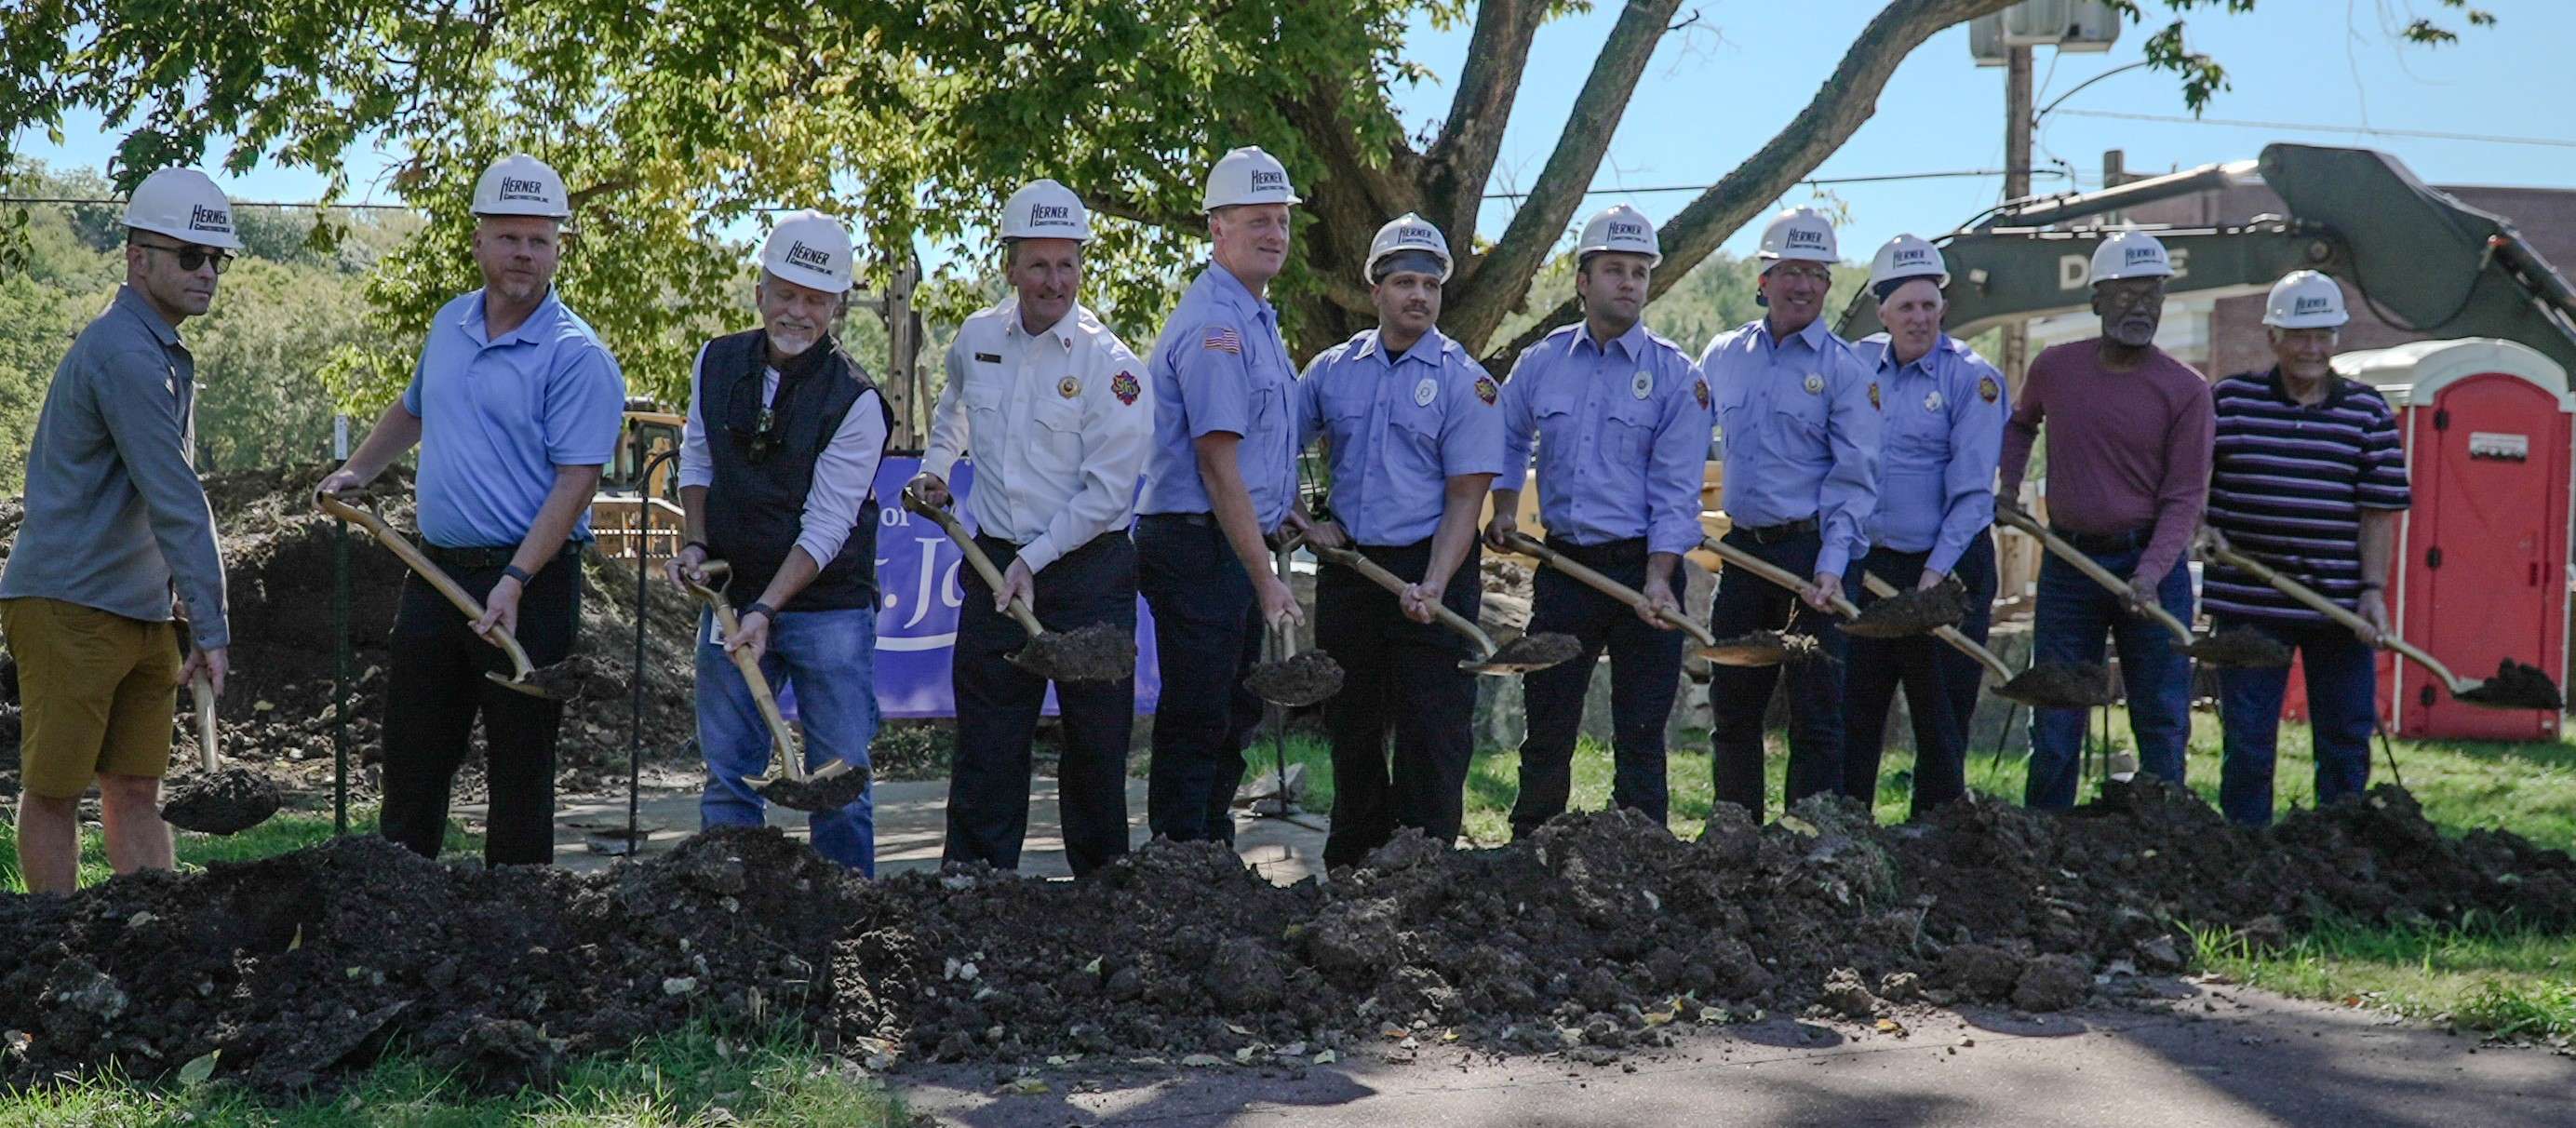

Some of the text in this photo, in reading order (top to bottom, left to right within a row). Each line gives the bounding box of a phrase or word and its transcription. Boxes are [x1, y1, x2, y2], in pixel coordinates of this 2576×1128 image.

[500, 176, 542, 201] HERNER
[1252, 168, 1282, 194] HERNER
[189, 204, 227, 230] HERNER
[1030, 203, 1068, 228] HERNER
[1397, 226, 1432, 245] HERNER
[1606, 221, 1642, 243] HERNER
[1785, 227, 1823, 249] HERNER
[785, 240, 830, 266] HERNER
